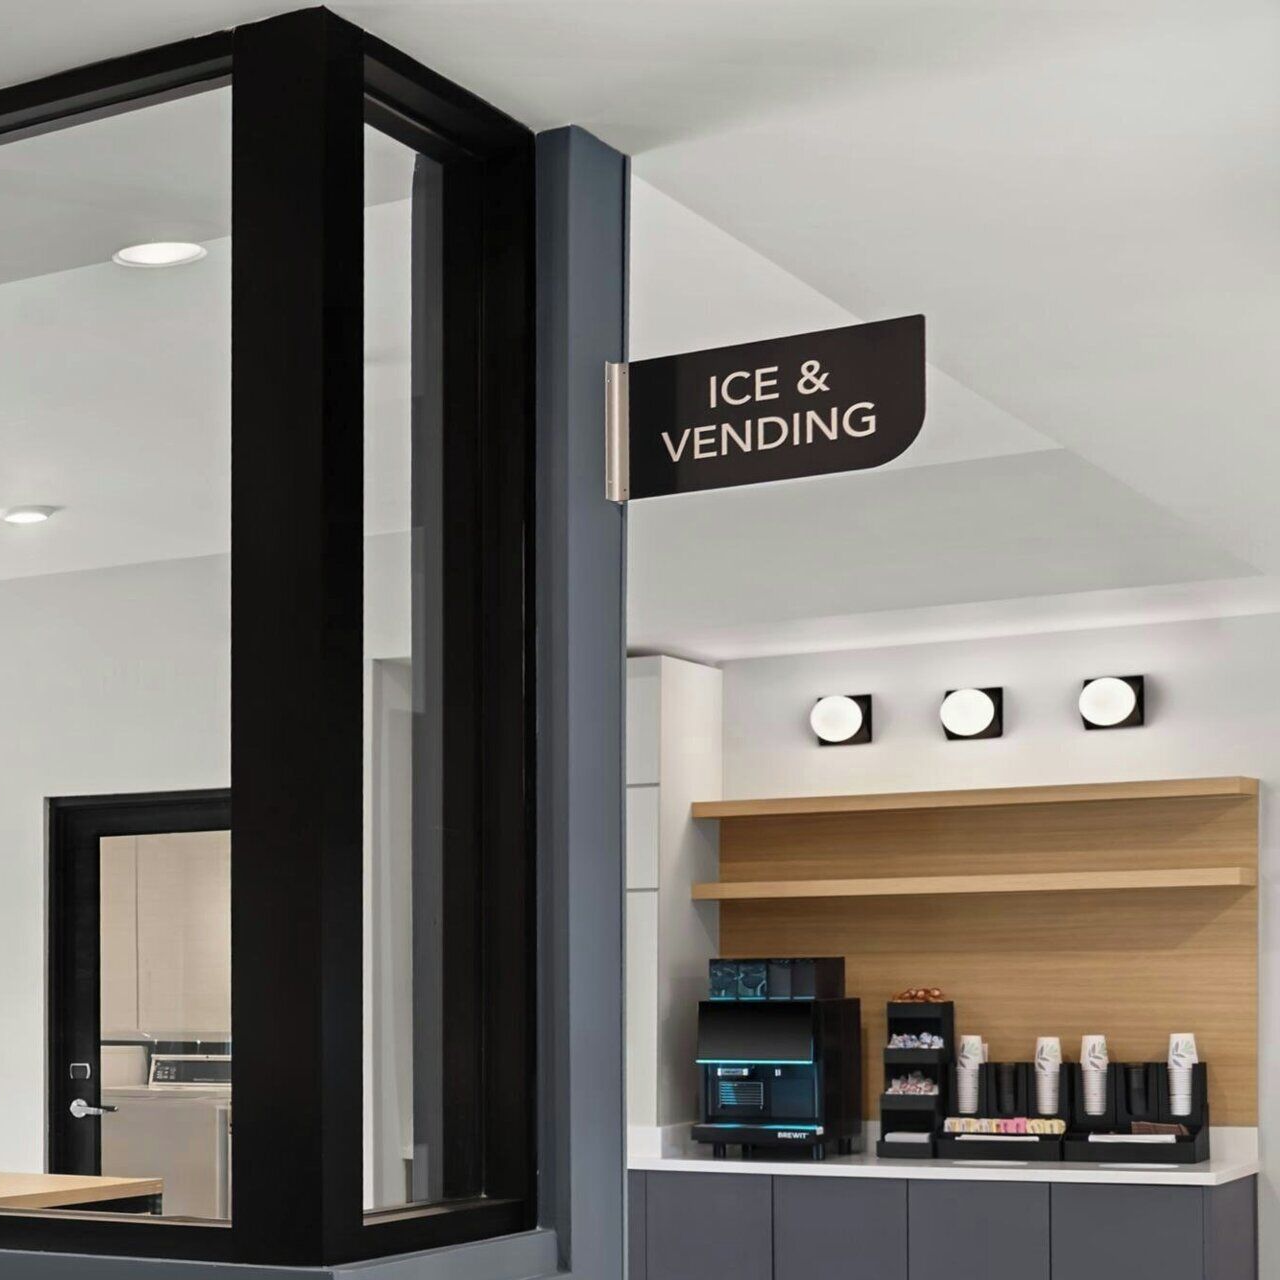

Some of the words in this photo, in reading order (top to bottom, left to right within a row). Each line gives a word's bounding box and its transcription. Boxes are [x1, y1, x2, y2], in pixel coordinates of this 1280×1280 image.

[709, 366, 780, 408] ICE
[796, 359, 831, 396] &
[661, 402, 878, 463] VENDING
[777, 1131, 807, 1139] BREWIT
